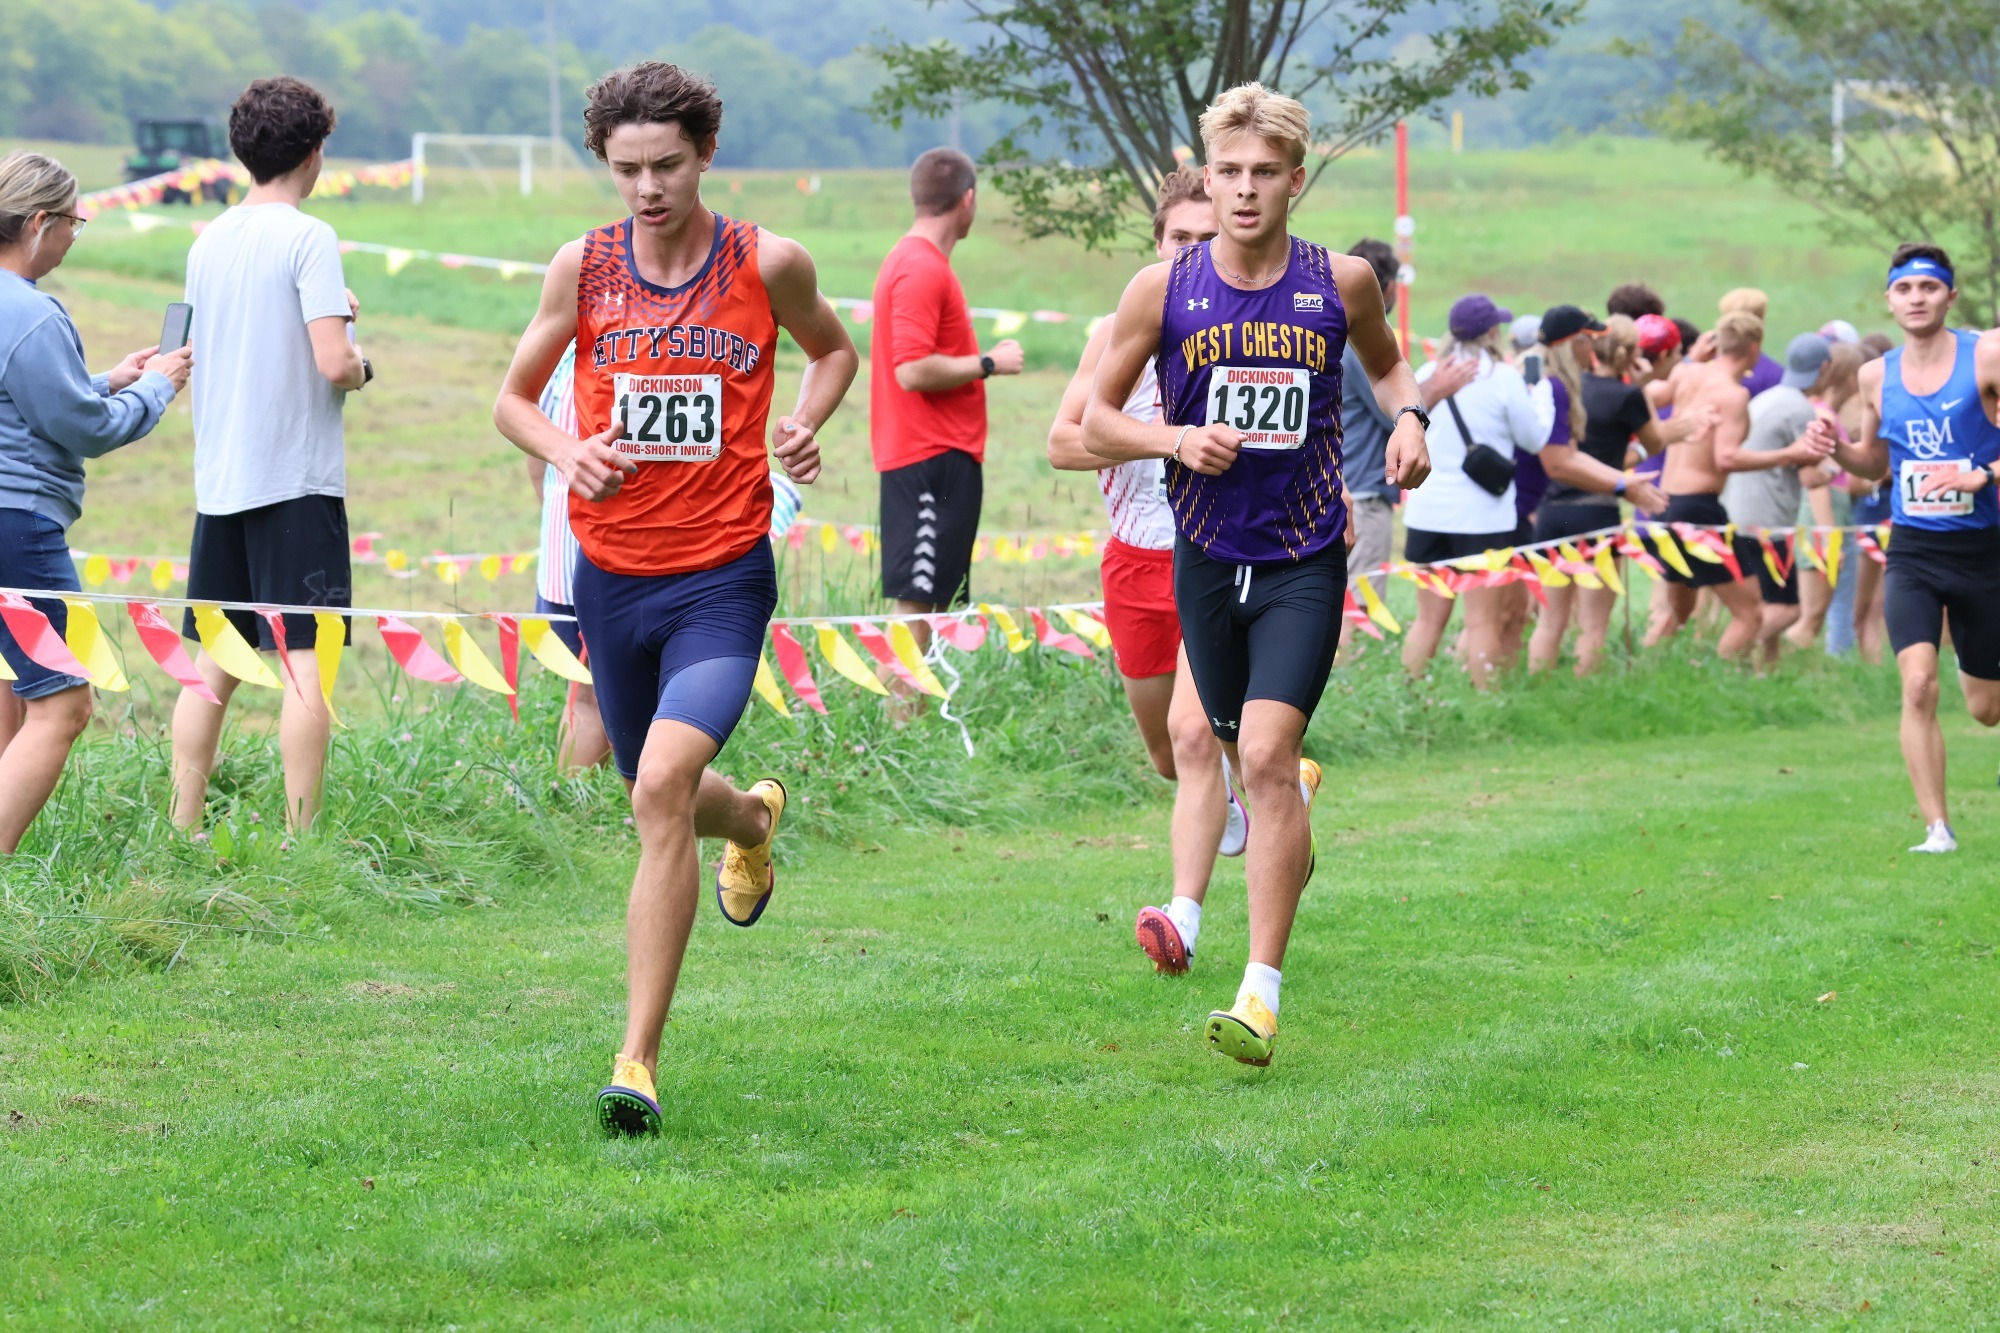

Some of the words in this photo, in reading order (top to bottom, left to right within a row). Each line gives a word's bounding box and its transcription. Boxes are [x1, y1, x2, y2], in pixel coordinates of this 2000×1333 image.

[1295, 298, 1321, 307] PSAC
[592, 325, 759, 375] ETTYSBURG
[1182, 323, 1233, 372] WEST
[1242, 321, 1327, 373] CHESTER
[1227, 369, 1294, 384] DICKINSON
[629, 377, 703, 393] DICKINSON
[1212, 385, 1304, 432] 1320
[618, 394, 714, 444] 1263
[1271, 433, 1299, 444] INVITE
[616, 442, 677, 456] LONG-SHORT
[680, 445, 712, 456] INVITE
